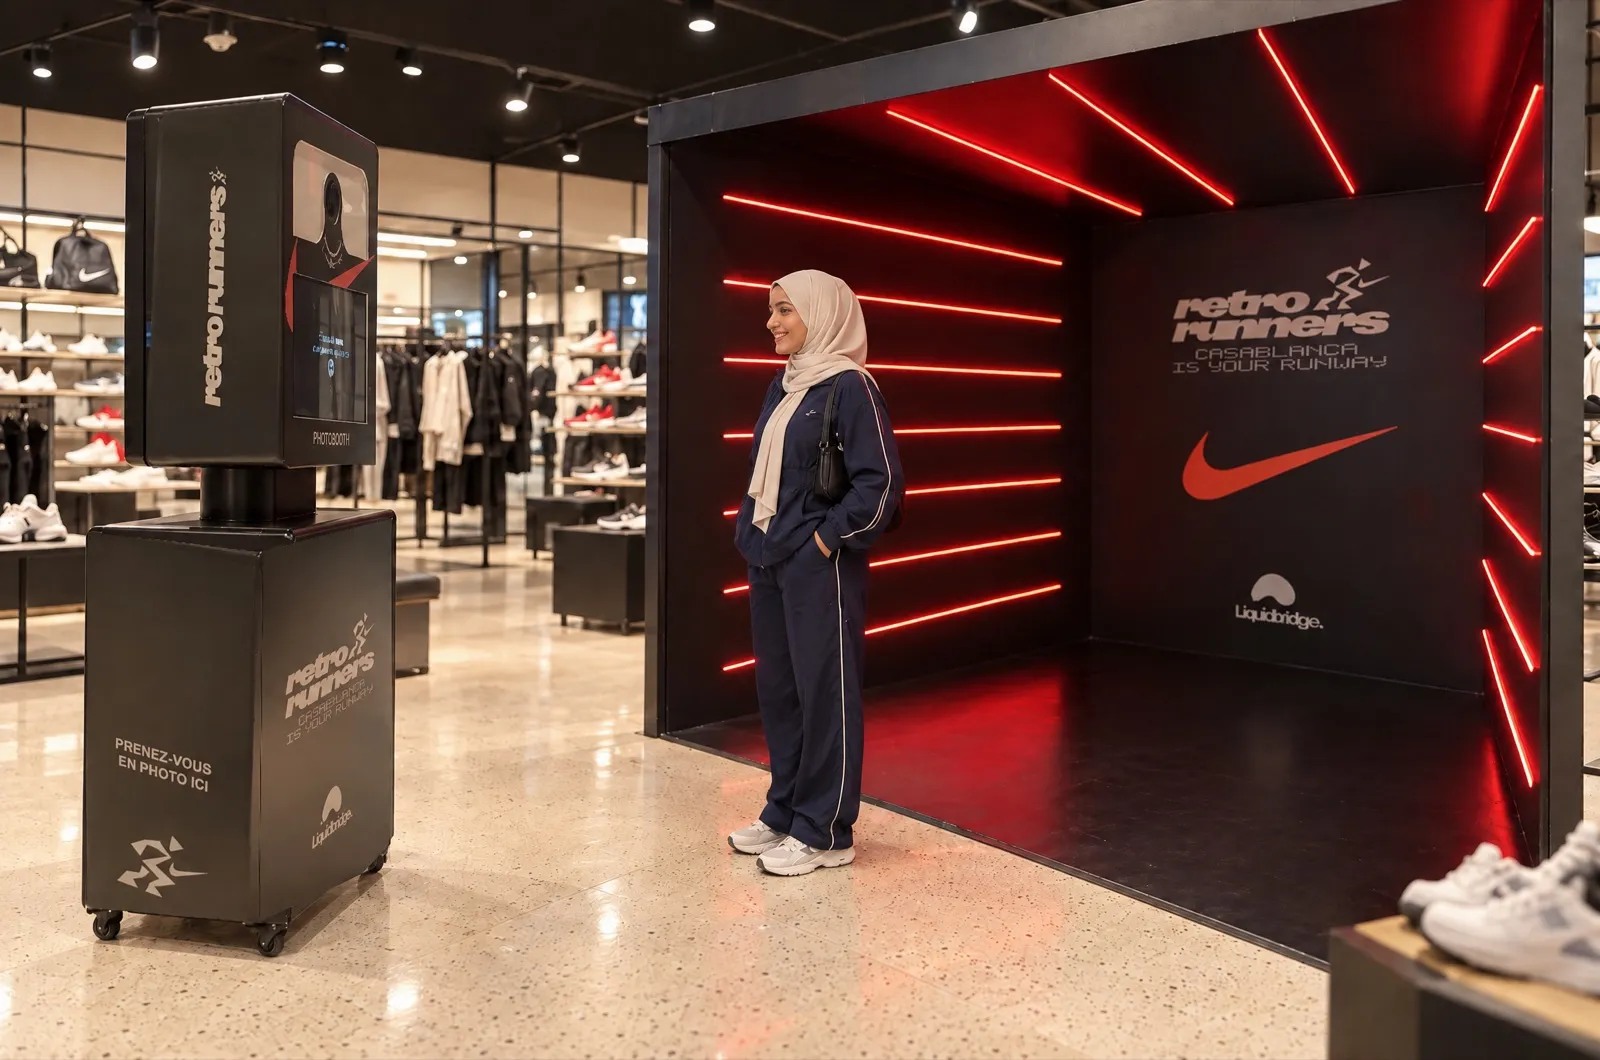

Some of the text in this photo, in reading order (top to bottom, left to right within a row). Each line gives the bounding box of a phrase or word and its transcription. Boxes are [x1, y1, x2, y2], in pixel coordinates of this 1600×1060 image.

[203, 185, 227, 407] retro runners
[1173, 290, 1311, 319] retro
[1172, 311, 1390, 343] runners
[1172, 355, 1388, 374] IS YOUR RUNWAY
[1195, 343, 1358, 361] CASABLANCA
[312, 431, 350, 446] PHOTOBOOTH
[1235, 604, 1324, 630] Liquidbridge.
[285, 645, 349, 696] retro
[285, 651, 375, 719] runners
[286, 683, 374, 746] IS YOUR RUNWAY
[298, 678, 366, 727] CASABLANCA
[115, 737, 212, 775] PRENEZ-VOUS
[118, 754, 208, 793] EN PHOTO ICI
